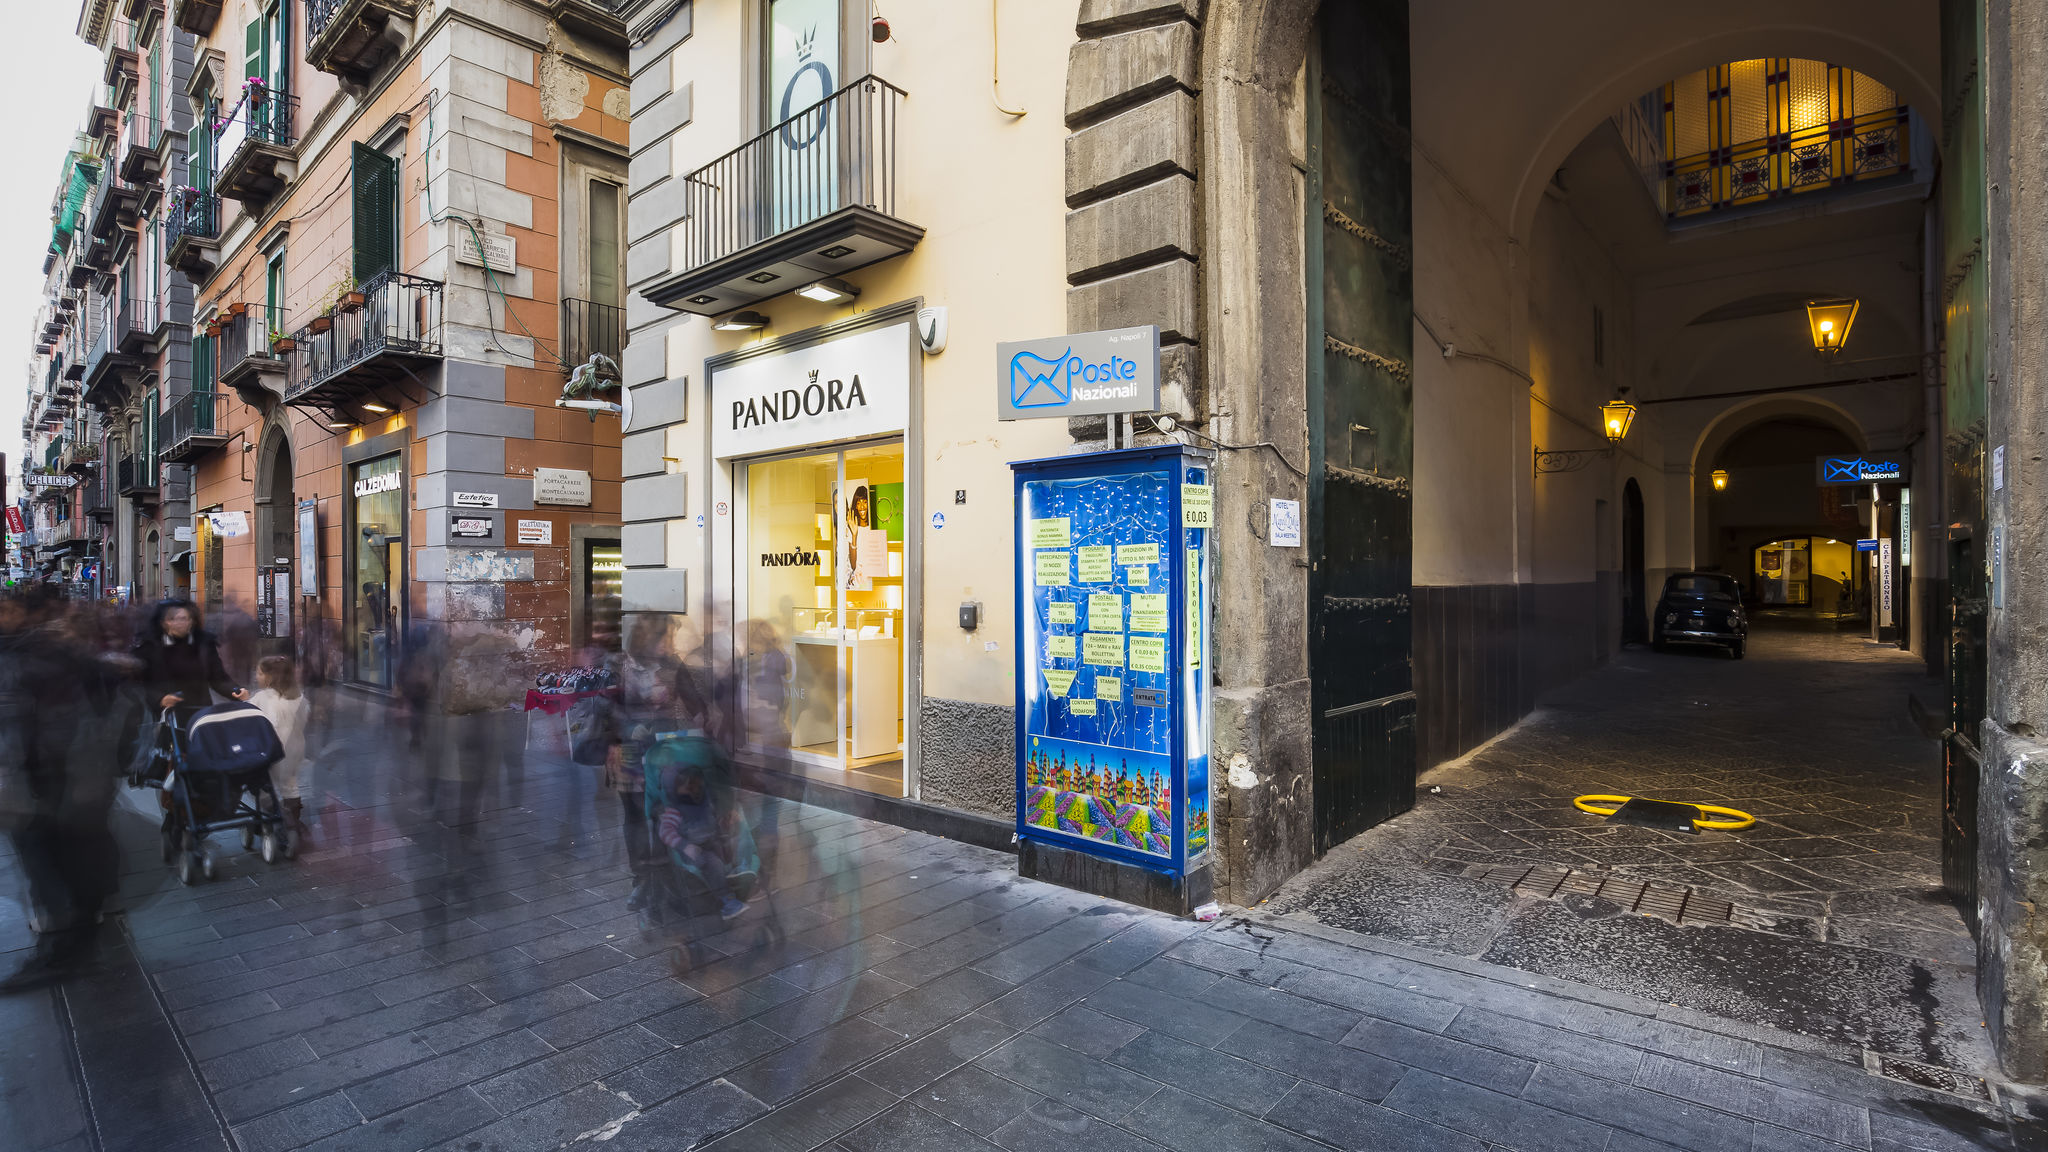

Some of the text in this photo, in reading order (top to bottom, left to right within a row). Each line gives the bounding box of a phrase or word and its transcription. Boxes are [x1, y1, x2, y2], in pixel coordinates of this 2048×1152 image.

[1120, 332, 1141, 342] Napoli
[1066, 355, 1137, 384] Poste
[1072, 382, 1138, 402] Nazionali
[732, 374, 868, 430] PANDORA
[1859, 460, 1900, 472] Poste
[1860, 472, 1900, 480] Nazionali
[354, 470, 402, 498] CALZEDONIA
[1192, 511, 1207, 524] 0,03
[761, 552, 821, 566] PANDORA
